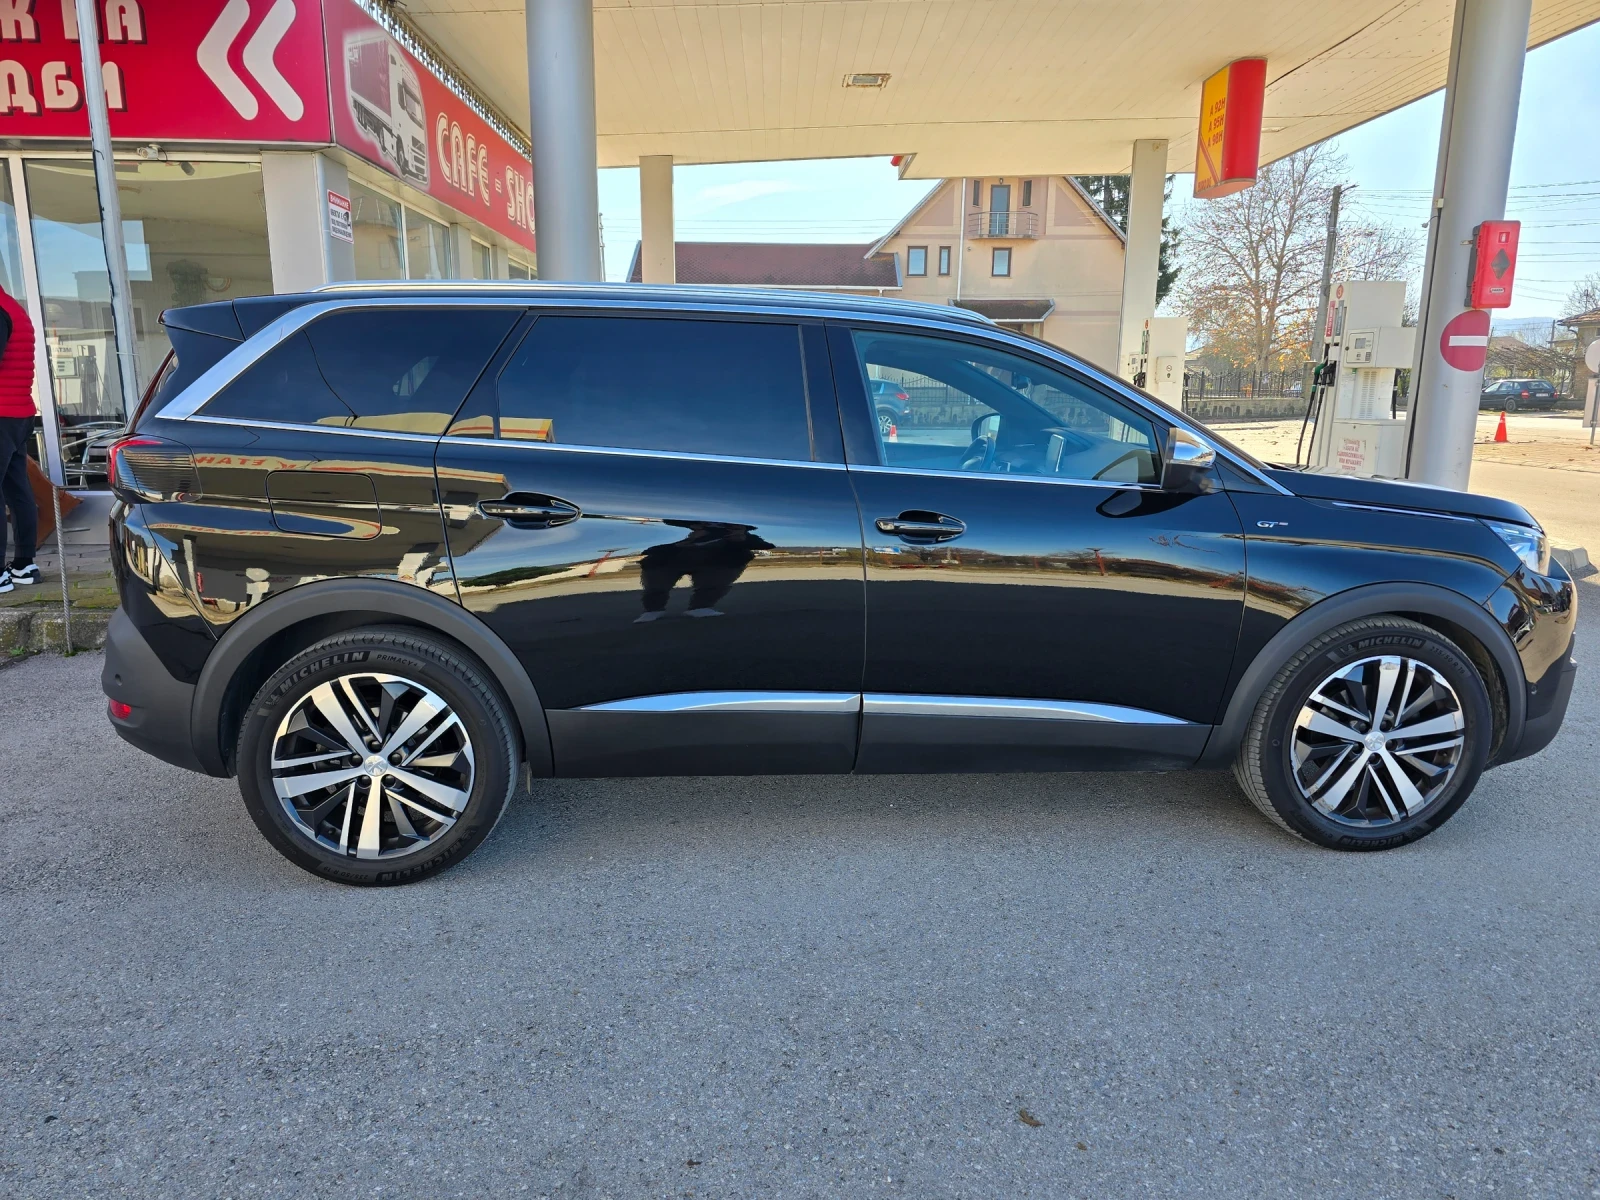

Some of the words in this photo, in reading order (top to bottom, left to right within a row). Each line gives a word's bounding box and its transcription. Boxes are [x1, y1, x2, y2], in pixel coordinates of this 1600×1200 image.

[436, 112, 490, 206] CAFE
[1256, 520, 1279, 528] GT
[1358, 636, 1423, 649] MICHELIN
[279, 651, 365, 694] MICHELIN
[377, 654, 414, 667] PRIMACY
[381, 839, 466, 882] MICHELIN
